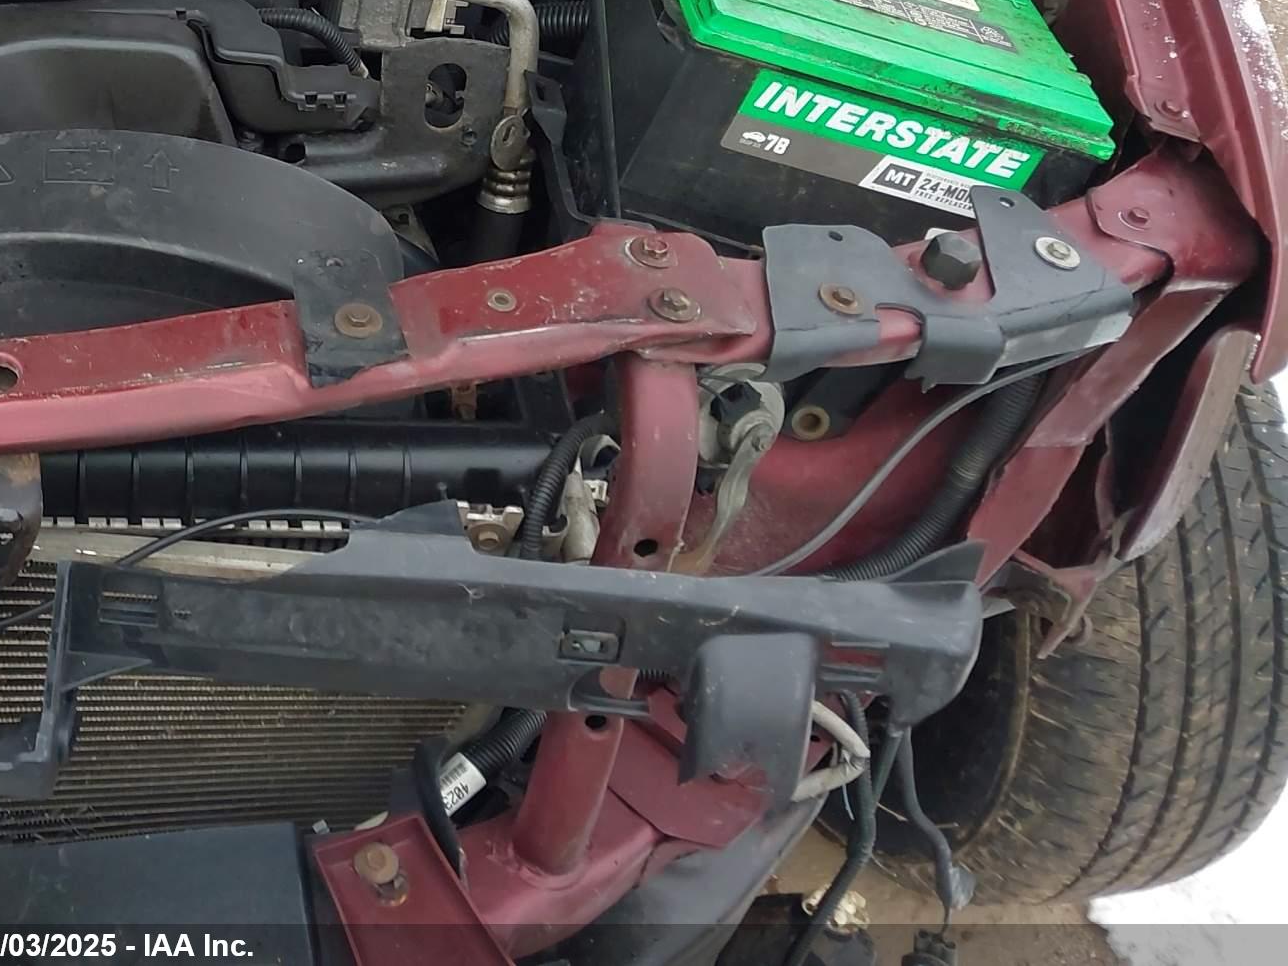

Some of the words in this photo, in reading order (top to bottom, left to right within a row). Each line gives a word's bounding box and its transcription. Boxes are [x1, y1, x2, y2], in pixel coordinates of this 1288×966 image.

[753, 81, 1031, 179] INTERSTATE
[765, 134, 791, 155] 78
[884, 169, 916, 187] MT
